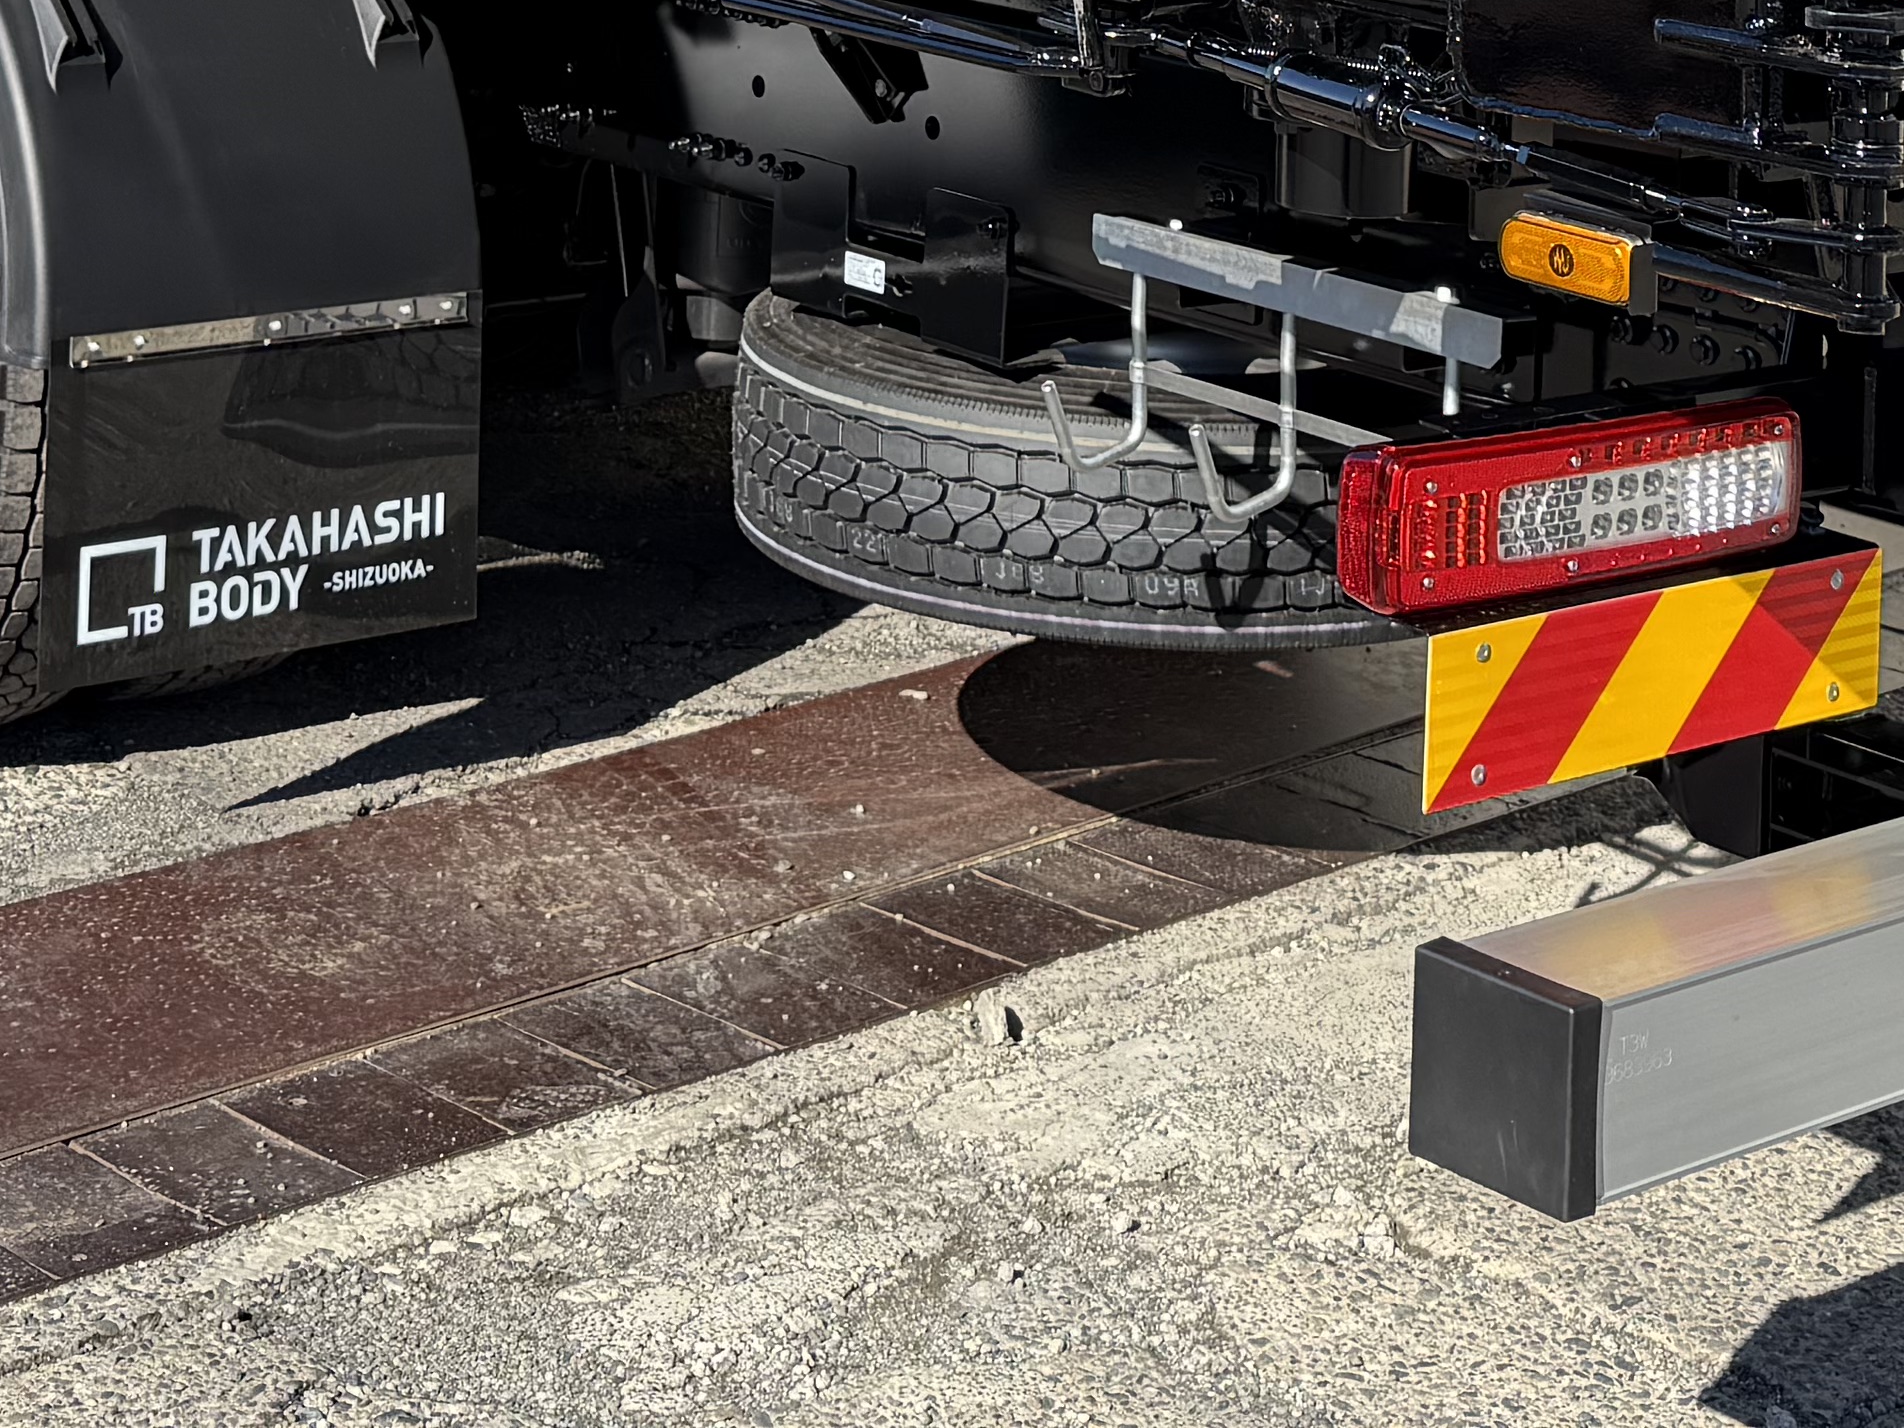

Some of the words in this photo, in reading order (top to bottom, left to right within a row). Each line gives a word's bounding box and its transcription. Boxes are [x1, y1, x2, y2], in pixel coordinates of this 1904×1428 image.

[192, 491, 445, 574] TAKAHASHI
[127, 602, 164, 638] TB
[189, 563, 309, 629] BODY
[323, 558, 434, 593] -SHIZUOKA-
